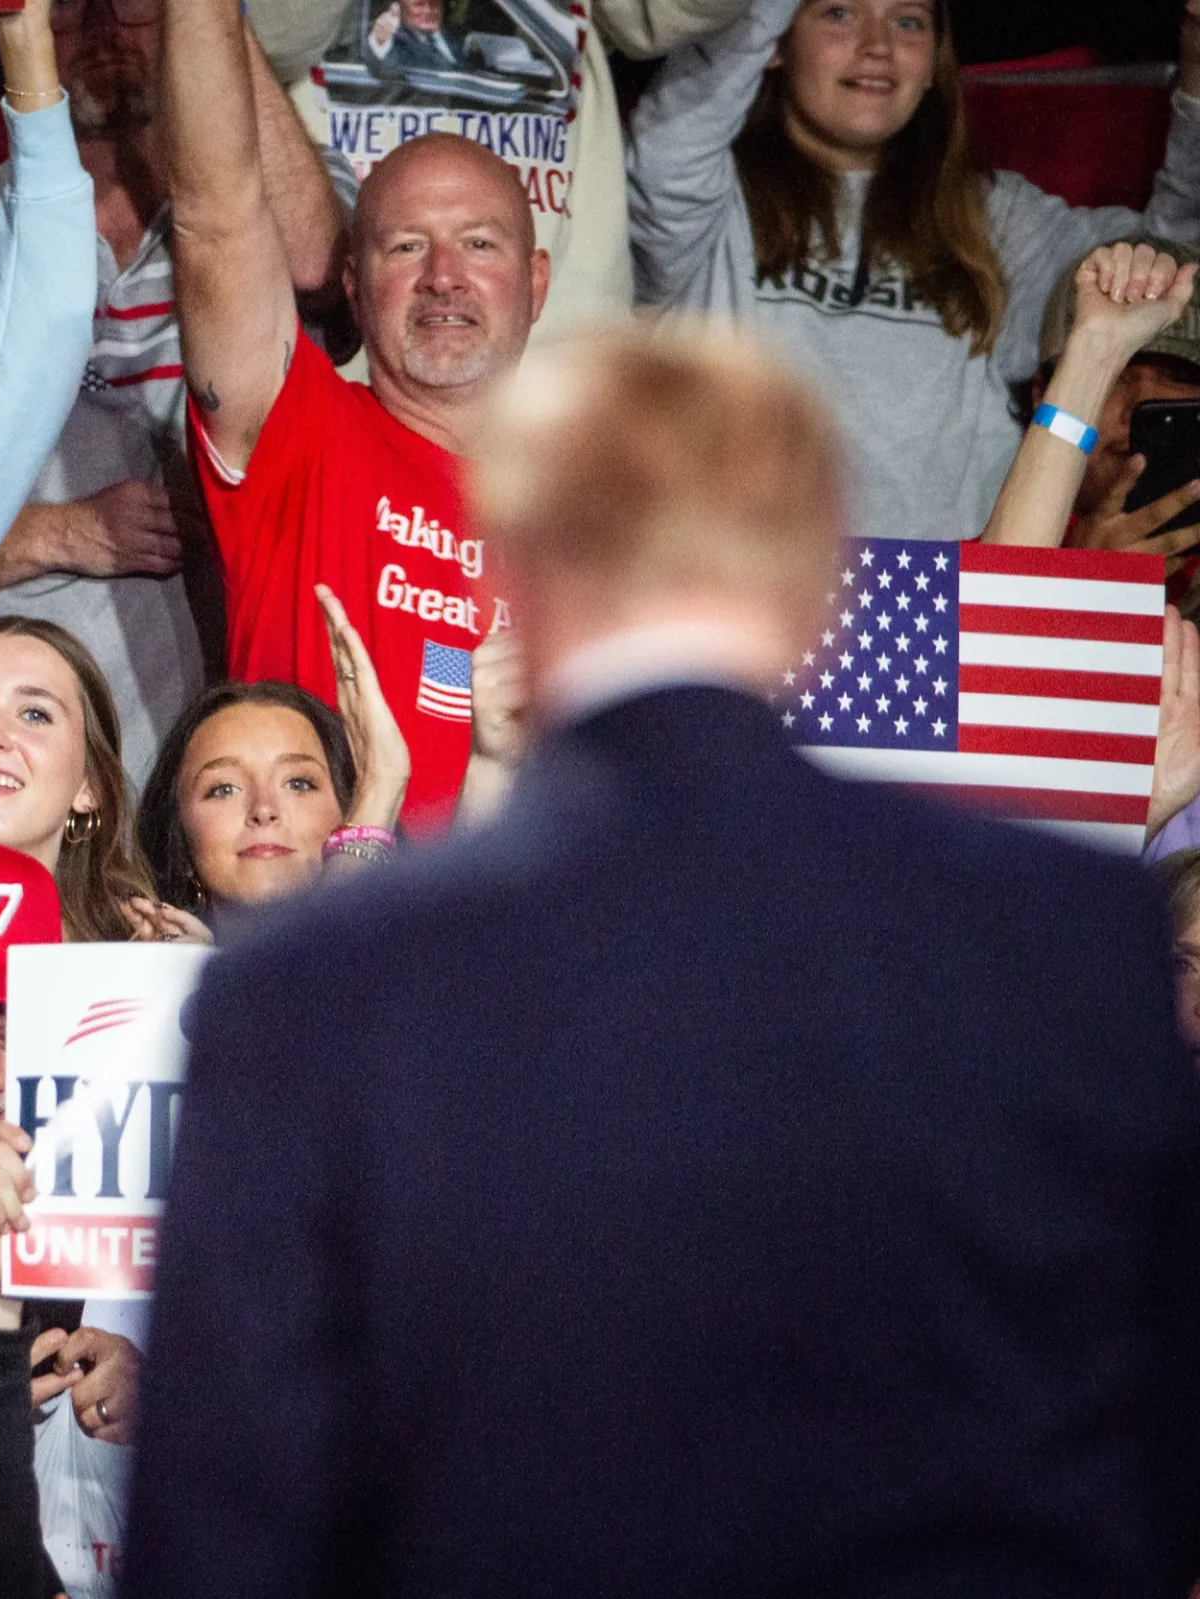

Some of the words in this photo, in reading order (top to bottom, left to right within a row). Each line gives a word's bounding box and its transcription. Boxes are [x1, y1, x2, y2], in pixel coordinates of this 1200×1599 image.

[455, 113, 569, 163] TAKING
[376, 564, 481, 635] Great
[15, 1225, 157, 1266] UNITE
